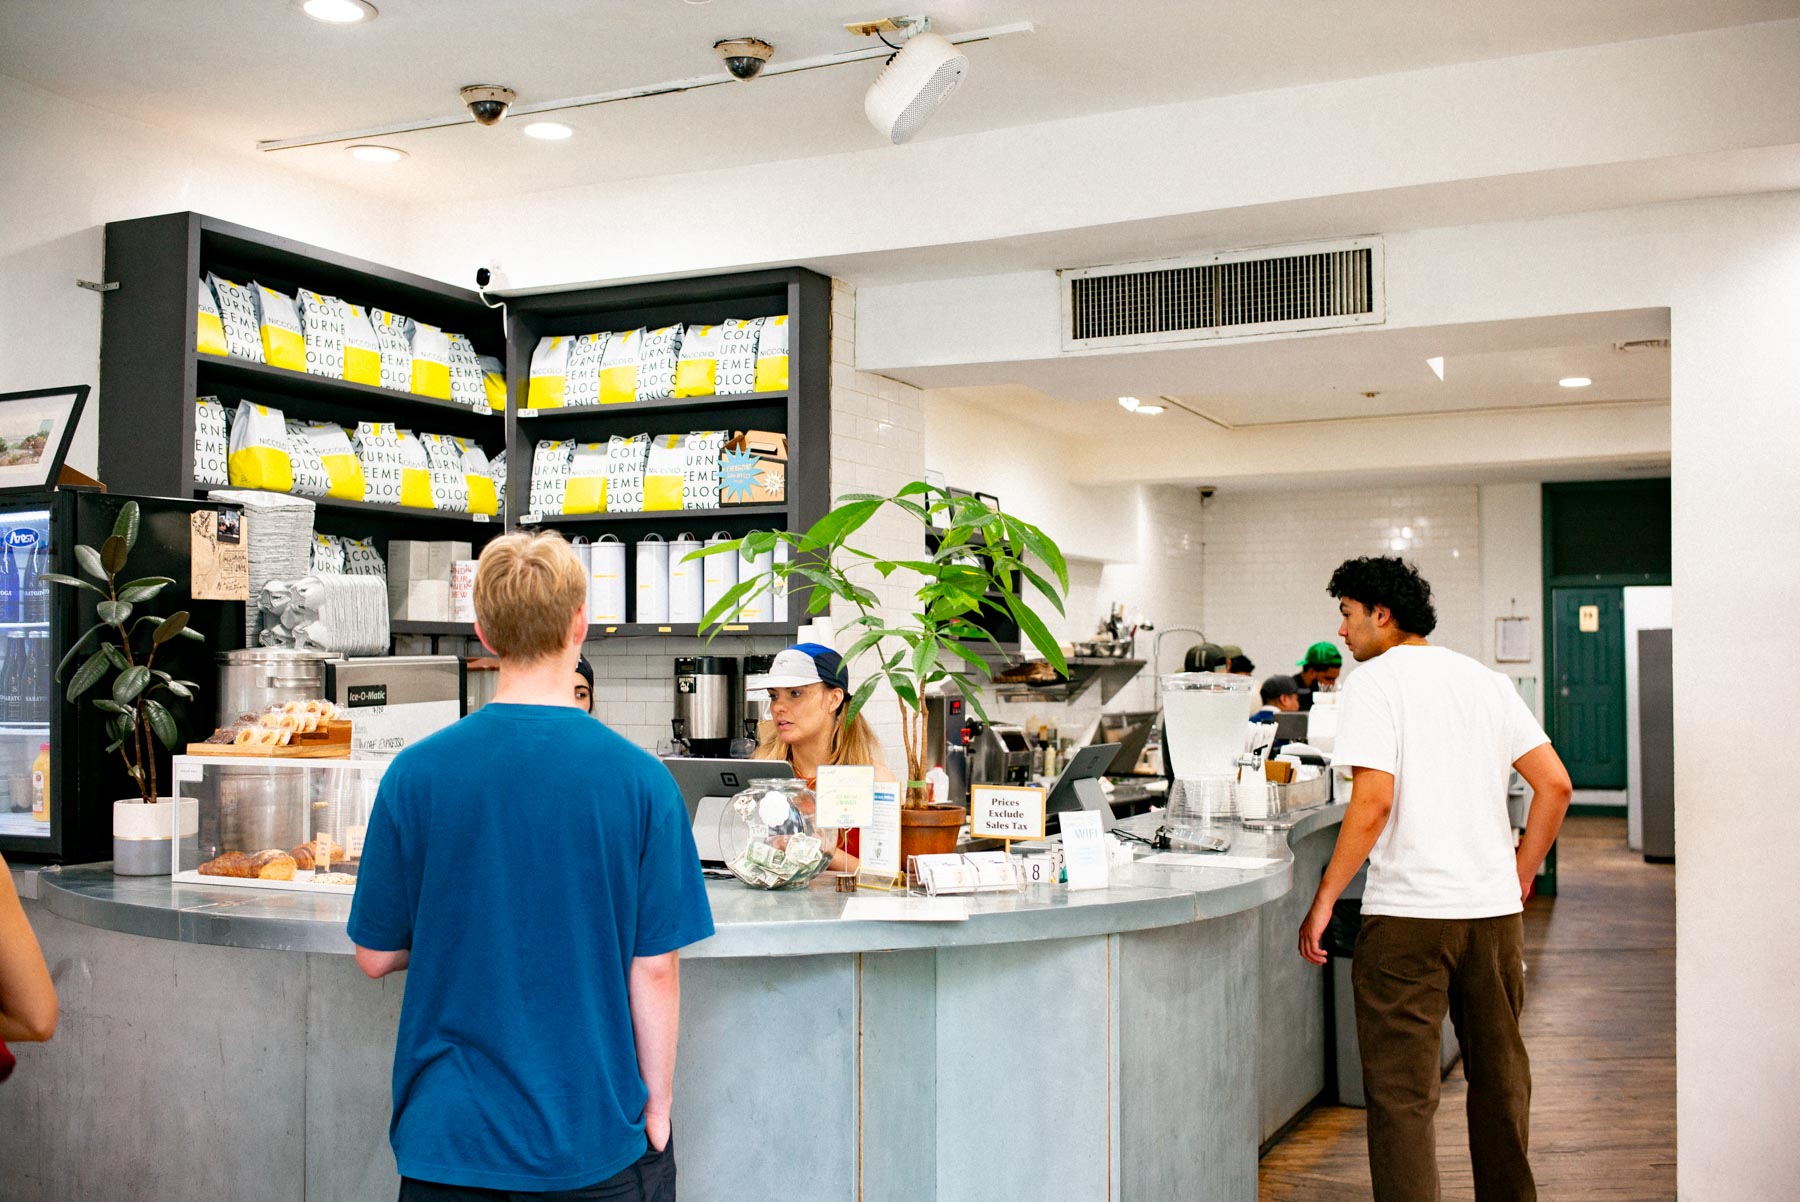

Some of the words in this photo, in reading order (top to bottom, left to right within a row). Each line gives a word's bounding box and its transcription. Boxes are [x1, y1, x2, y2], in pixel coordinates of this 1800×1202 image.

[681, 350, 715, 359] NICCOLO
[349, 690, 386, 702] Ice-O-Matic
[991, 798, 1020, 806] Prices
[988, 810, 1024, 819] Exclude
[985, 821, 1009, 830] Sales
[1012, 822, 1028, 831] Tax
[1074, 828, 1098, 839] WIFI
[1032, 864, 1040, 880] 8
